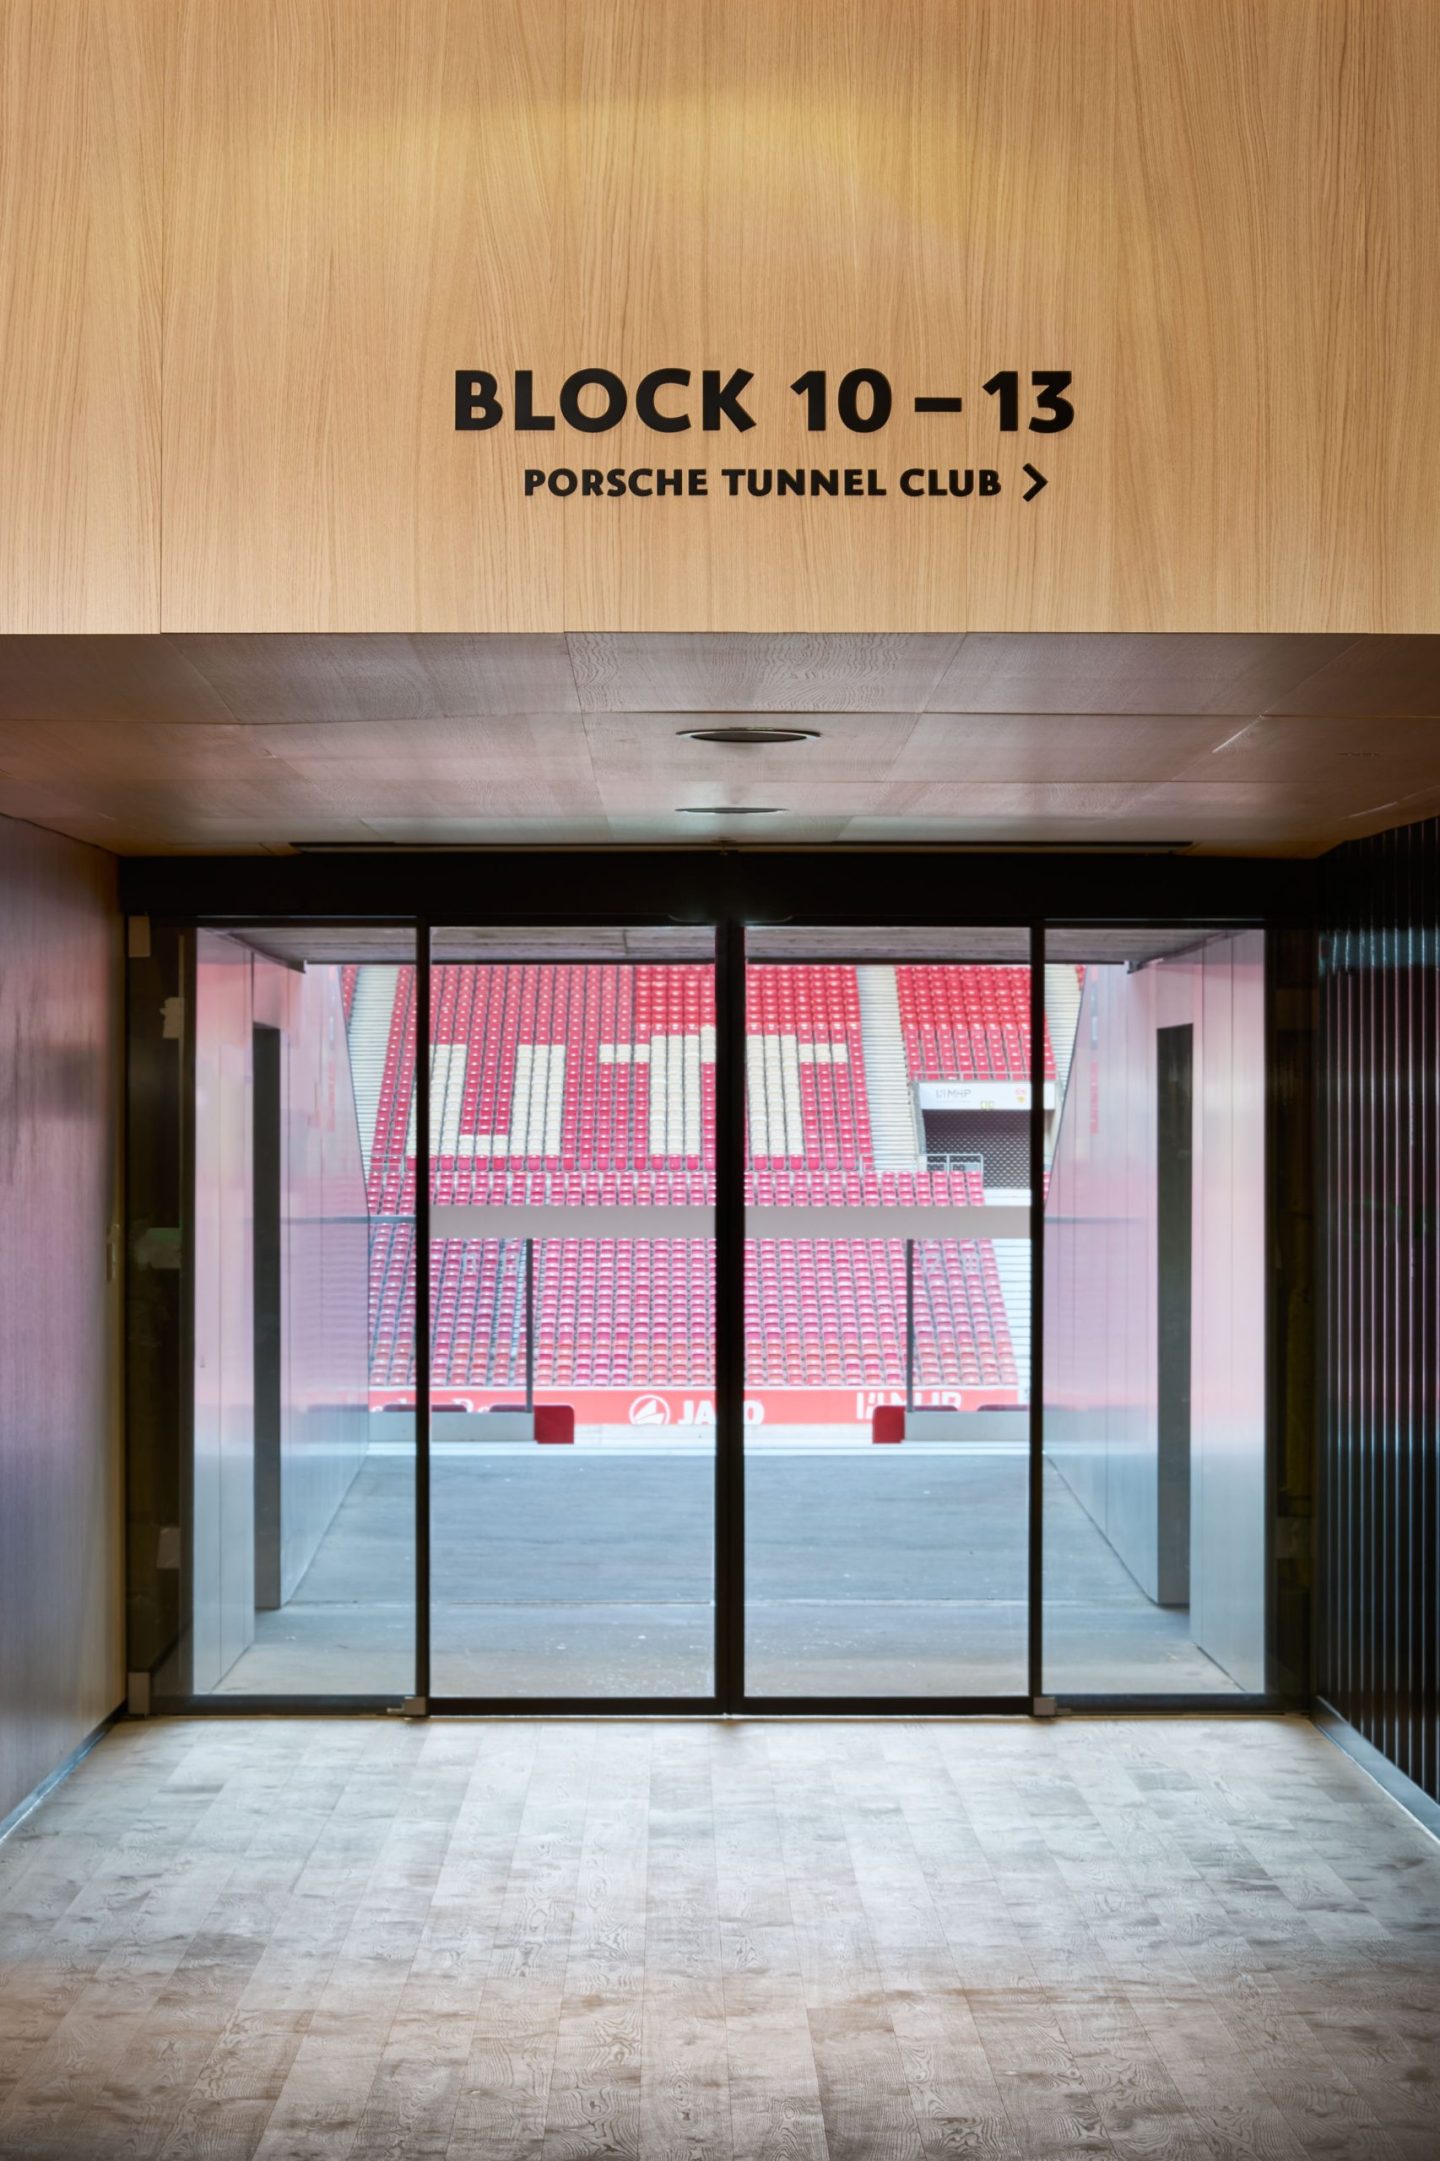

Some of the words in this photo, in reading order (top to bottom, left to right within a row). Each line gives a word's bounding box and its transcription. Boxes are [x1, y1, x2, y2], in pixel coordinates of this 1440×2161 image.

[455, 367, 757, 434] BLOCK
[790, 367, 893, 434] 10
[982, 370, 1075, 434] 13
[525, 468, 709, 498] PORSCHE
[721, 468, 887, 497] TUNNEL
[899, 468, 1002, 498] CLUB
[678, 1399, 765, 1425] JAO
